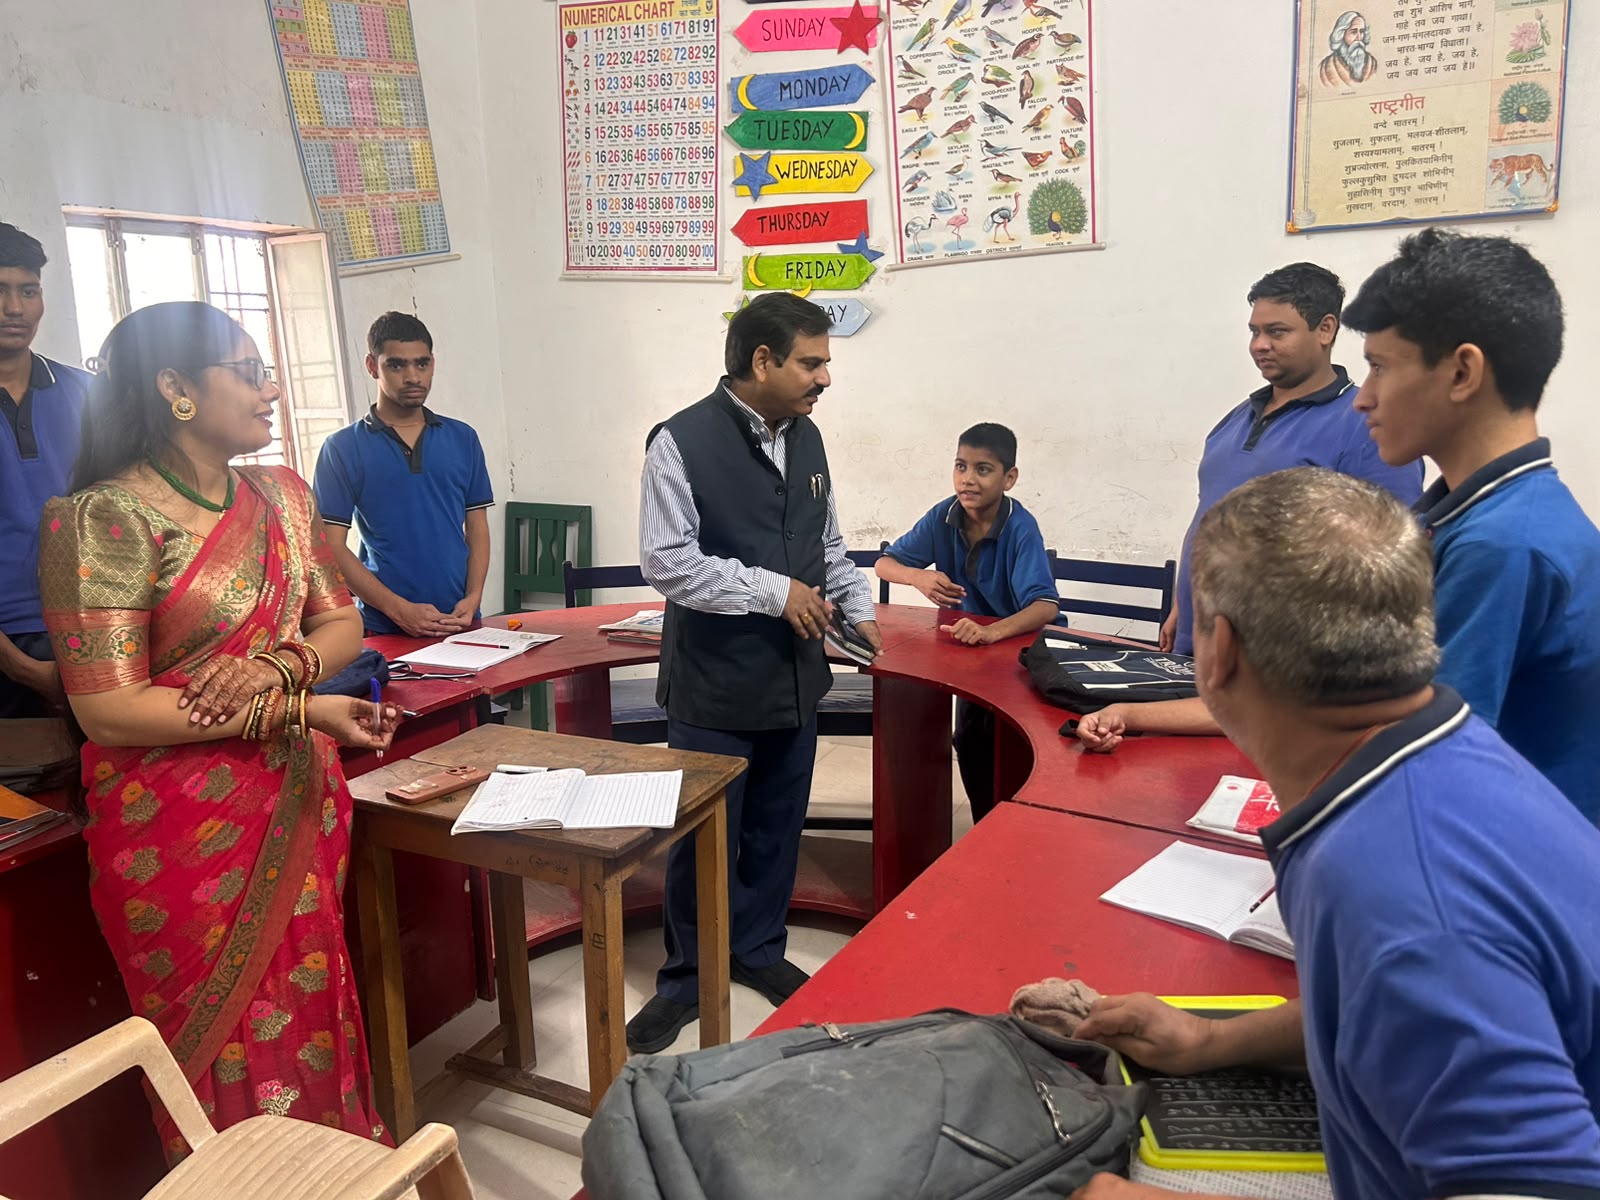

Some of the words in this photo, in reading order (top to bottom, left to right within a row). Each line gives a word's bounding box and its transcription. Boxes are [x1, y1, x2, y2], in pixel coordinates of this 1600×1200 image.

[564, 4, 632, 26] NUMERICAL
[635, 1, 675, 18] CHART
[1393, 10, 1404, 18] तव
[1410, 7, 1423, 18] शुभ
[584, 30, 587, 42] 1
[594, 28, 605, 41] 11
[607, 27, 618, 40] 21
[620, 26, 631, 39] 31
[633, 25, 644, 38] 41
[646, 23, 658, 37] 51
[660, 22, 672, 36] 61
[674, 21, 686, 35] 71
[687, 20, 700, 34] 81
[702, 18, 715, 33] 91
[762, 17, 826, 41] SUNDAY
[1395, 20, 1408, 30] गाहे
[1414, 19, 1425, 27] तव
[1432, 16, 1444, 24] जय
[1457, 25, 1470, 33] जय
[584, 55, 589, 67] 2
[594, 53, 606, 66] 12
[607, 52, 619, 65] 22
[620, 51, 632, 64] 32
[633, 50, 645, 63] 42
[647, 49, 659, 62] 52
[660, 48, 672, 61] 62
[674, 47, 686, 60] 72
[688, 45, 701, 60] 82
[702, 44, 715, 59] 92
[1047, 55, 1074, 64] PARTRIDGE
[1385, 59, 1398, 68] जय
[1418, 55, 1431, 63] जय
[1452, 50, 1465, 58] जय
[1387, 71, 1399, 80] जय
[1405, 69, 1418, 77] जय
[1424, 66, 1437, 74] जय
[1443, 64, 1456, 72] जय
[779, 74, 851, 101] MONDAY
[981, 87, 1016, 96] WOOD-PECKER
[585, 103, 590, 115] 4
[595, 102, 607, 115] 14
[607, 101, 620, 114] 24
[620, 100, 633, 114] 34
[634, 100, 646, 113] 44
[647, 99, 660, 112] 54
[660, 98, 673, 111] 64
[674, 97, 687, 111] 74
[688, 96, 701, 110] 84
[702, 95, 716, 110] 94
[1369, 93, 1426, 115] राष्ट्रगीत
[754, 119, 835, 141] TUESDAY
[1373, 119, 1387, 129] वन्दे
[585, 151, 591, 163] 6
[595, 150, 609, 163] 16
[608, 150, 621, 163] 26
[621, 149, 634, 162] 36
[634, 149, 647, 162] 46
[647, 148, 661, 161] 56
[660, 148, 674, 161] 66
[674, 147, 688, 160] 76
[688, 146, 702, 160] 86
[702, 146, 716, 160] 96
[775, 159, 858, 179] WEDNESDAY
[587, 199, 592, 211] 8
[595, 198, 610, 211] 18
[608, 198, 622, 210] 28
[621, 197, 635, 210] 38
[634, 197, 648, 210] 48
[647, 197, 661, 210] 58
[661, 197, 674, 209] 68
[674, 196, 688, 209] 78
[688, 196, 702, 209] 88
[702, 195, 716, 209] 98
[757, 211, 830, 234] THURSDAY
[586, 245, 596, 257] 10
[596, 245, 610, 257] 20
[608, 245, 623, 257] 30
[621, 245, 635, 257] 40
[634, 245, 648, 257] 50
[647, 245, 661, 257] 60
[661, 245, 675, 257] 70
[674, 245, 688, 257] 80
[688, 244, 702, 258] 90
[702, 244, 714, 257] 100
[785, 260, 847, 279] FRIDAY
